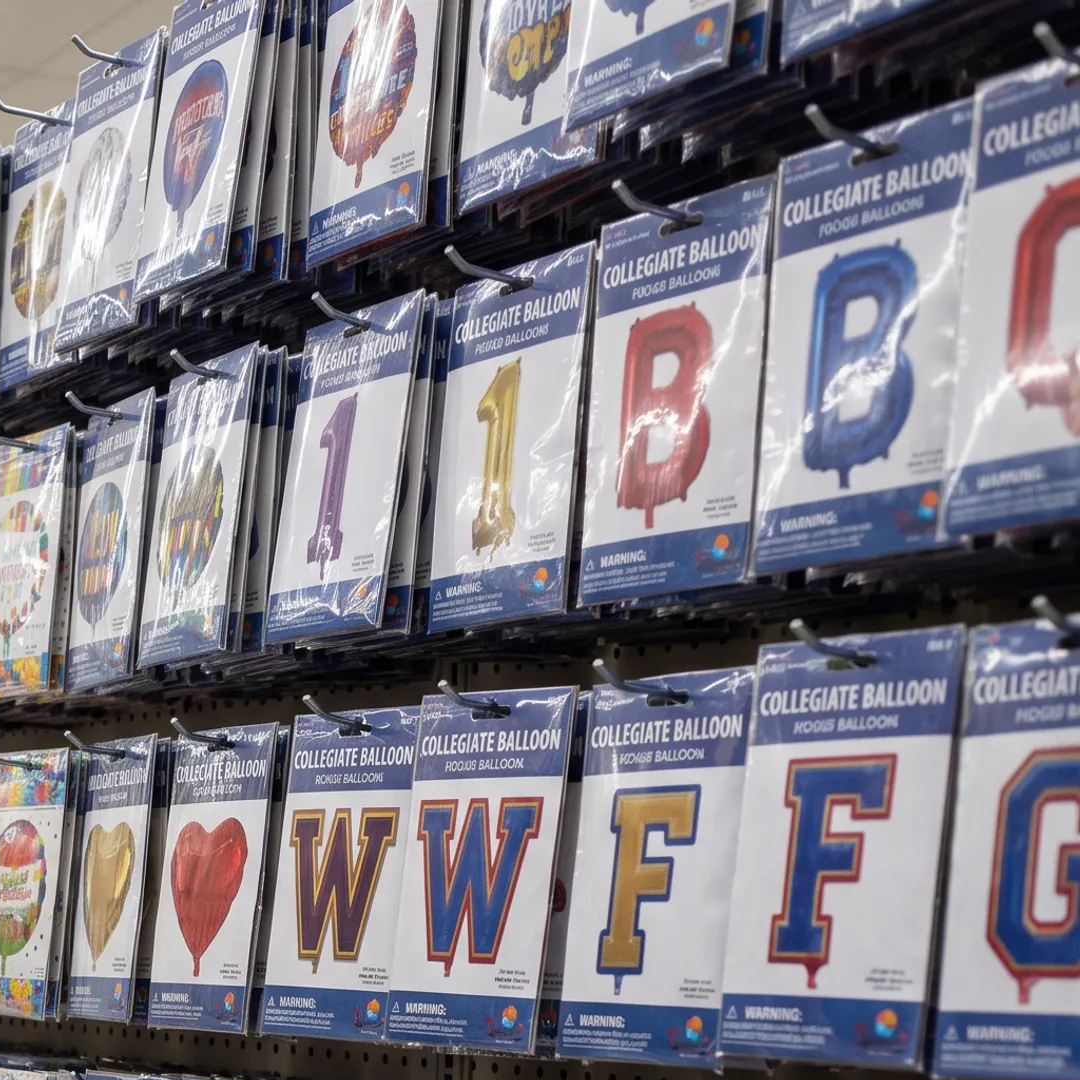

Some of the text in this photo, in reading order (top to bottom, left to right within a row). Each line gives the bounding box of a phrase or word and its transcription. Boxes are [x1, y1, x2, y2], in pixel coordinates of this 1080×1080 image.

[783, 148, 971, 227] COLLEGIATE BALLOON
[603, 225, 761, 289] COLLEGIATE BALLOON
[455, 287, 581, 344] COLLEGIATE BALLOON
[760, 678, 948, 716] COLLEGIATE BALLOON
[294, 745, 414, 769] COLLEGIATE BALLOON
[421, 729, 562, 757] COLLEGIATE BALLOON
[591, 714, 744, 748] COLLEGIATE BALLOON
[289, 807, 400, 961] W
[417, 797, 544, 965] W
[596, 784, 701, 976] F
[768, 753, 898, 964] F
